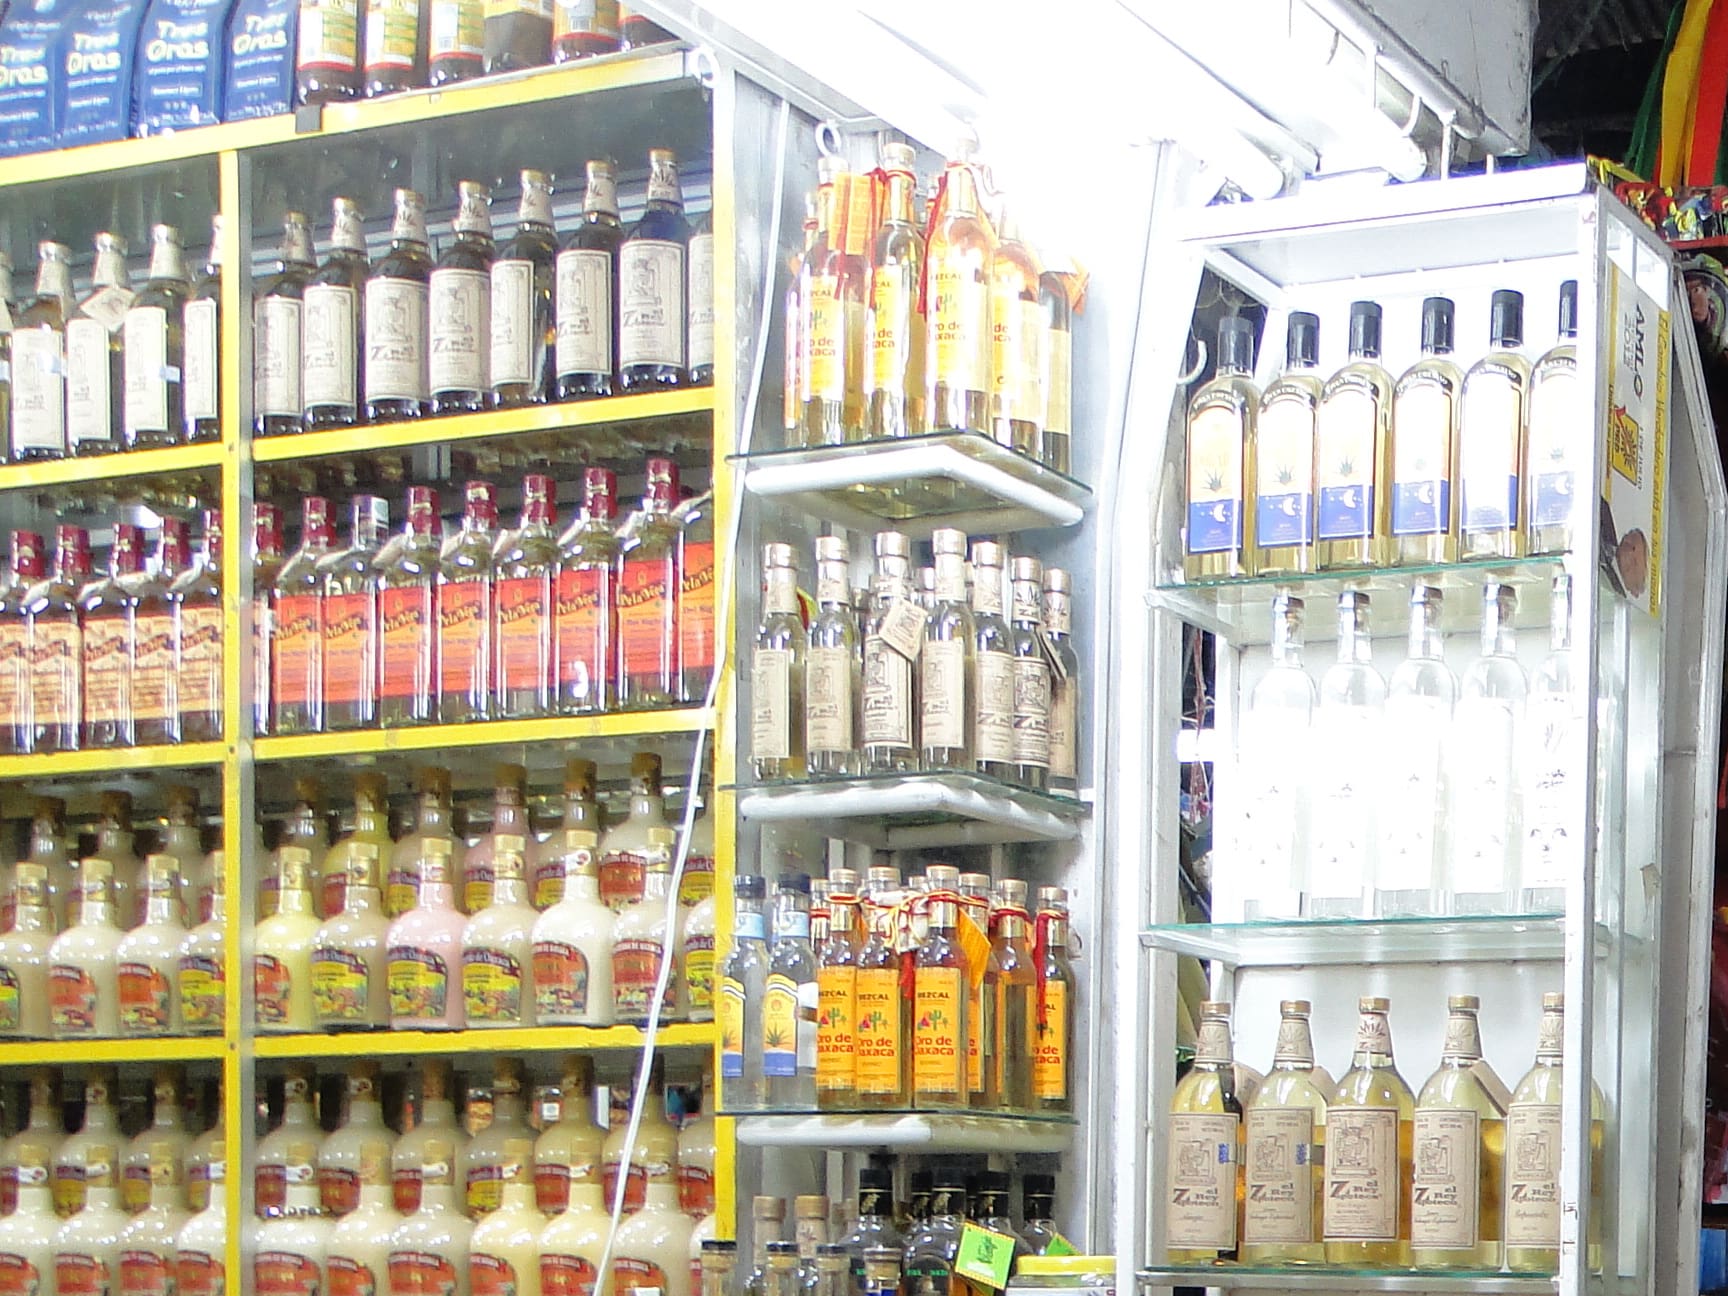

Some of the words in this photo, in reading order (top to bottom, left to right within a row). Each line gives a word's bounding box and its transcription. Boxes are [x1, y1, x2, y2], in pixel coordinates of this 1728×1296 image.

[1633, 303, 1645, 400] AMLO
[835, 1033, 852, 1043] de
[875, 1037, 893, 1047] de
[936, 1036, 952, 1046] de
